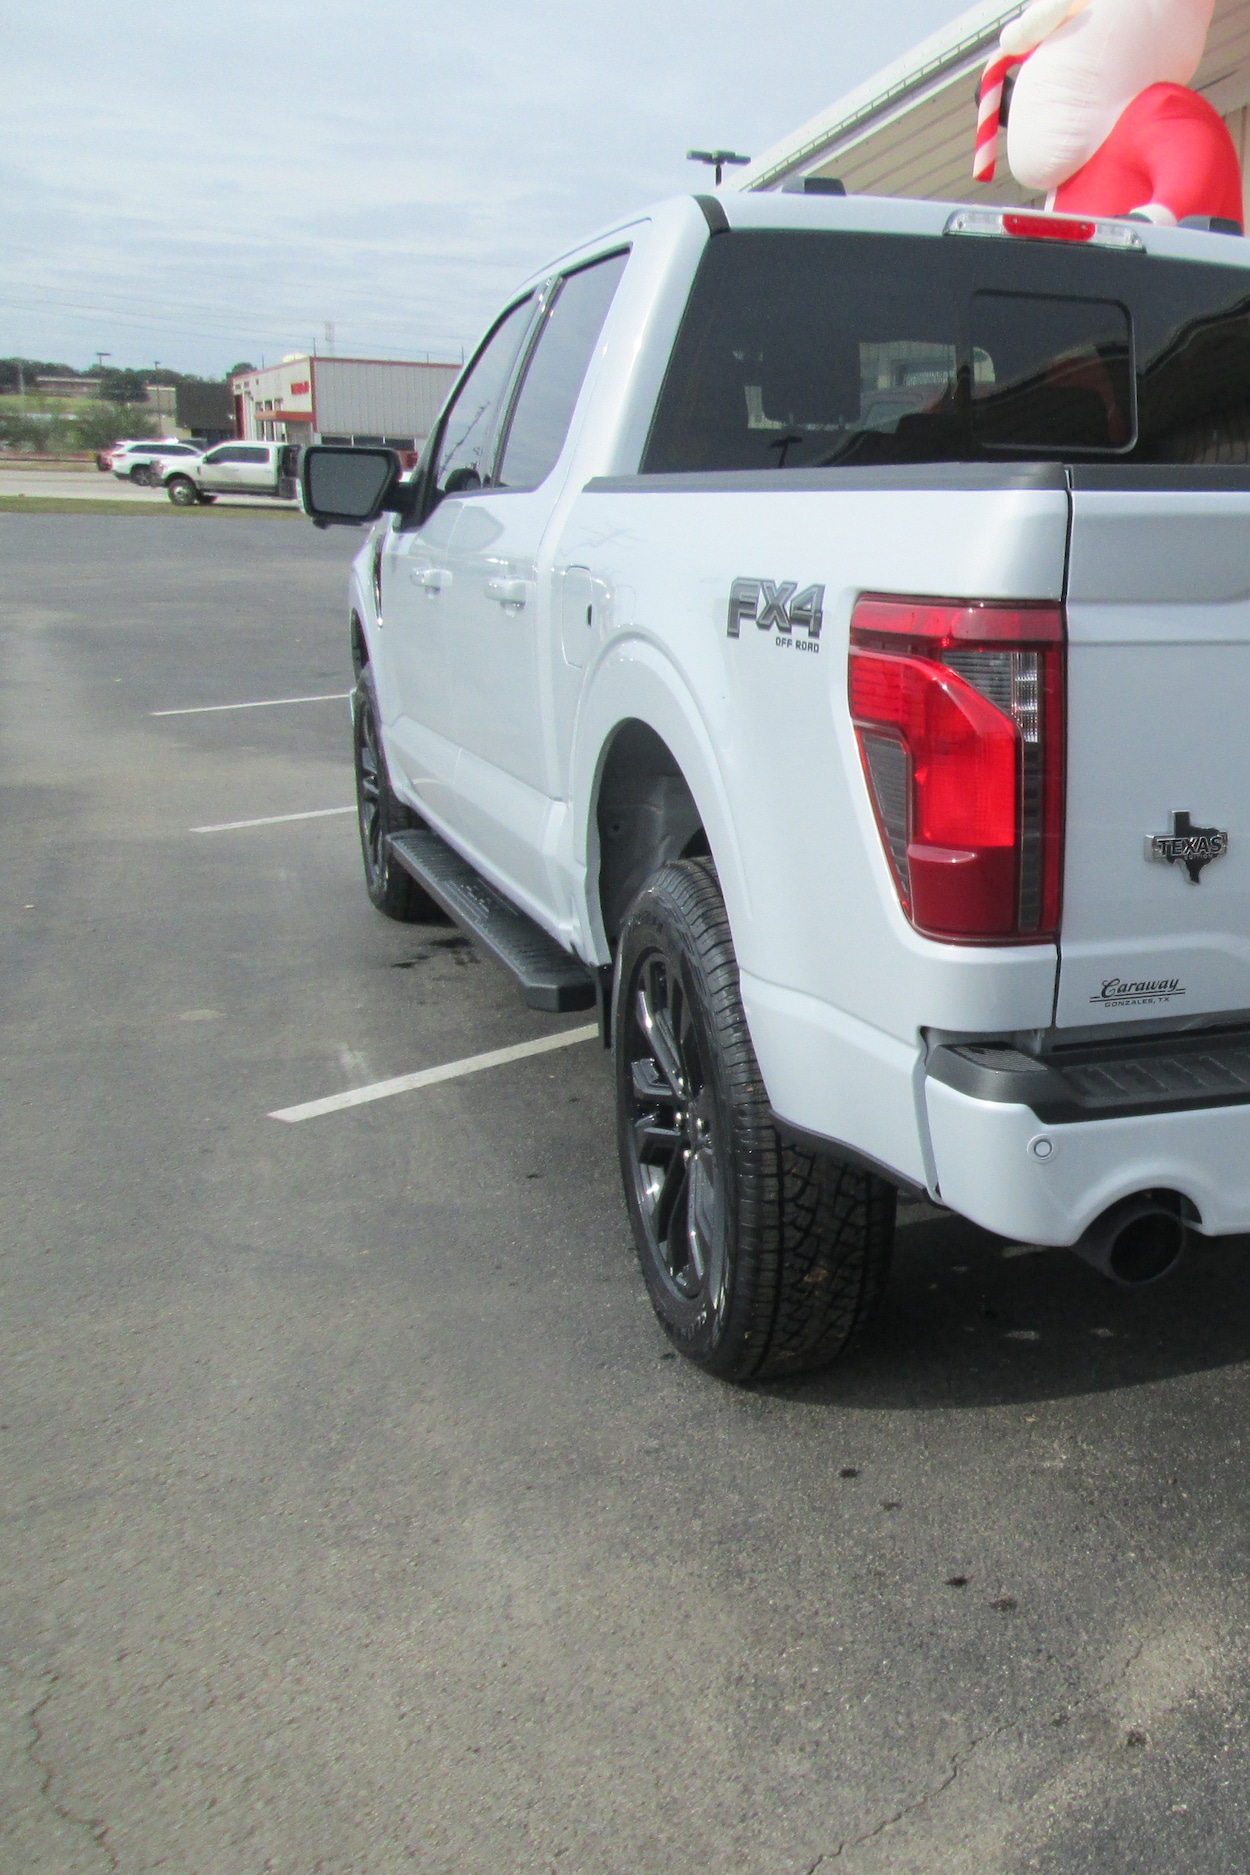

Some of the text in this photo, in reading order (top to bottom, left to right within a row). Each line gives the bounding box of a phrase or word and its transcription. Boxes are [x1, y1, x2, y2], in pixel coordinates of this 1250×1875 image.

[726, 576, 826, 639] FX4
[775, 636, 820, 653] OFF ROAD
[1157, 836, 1222, 856] TEXAS
[1101, 978, 1180, 998] Caraway
[1104, 998, 1156, 1008] GONZALES,
